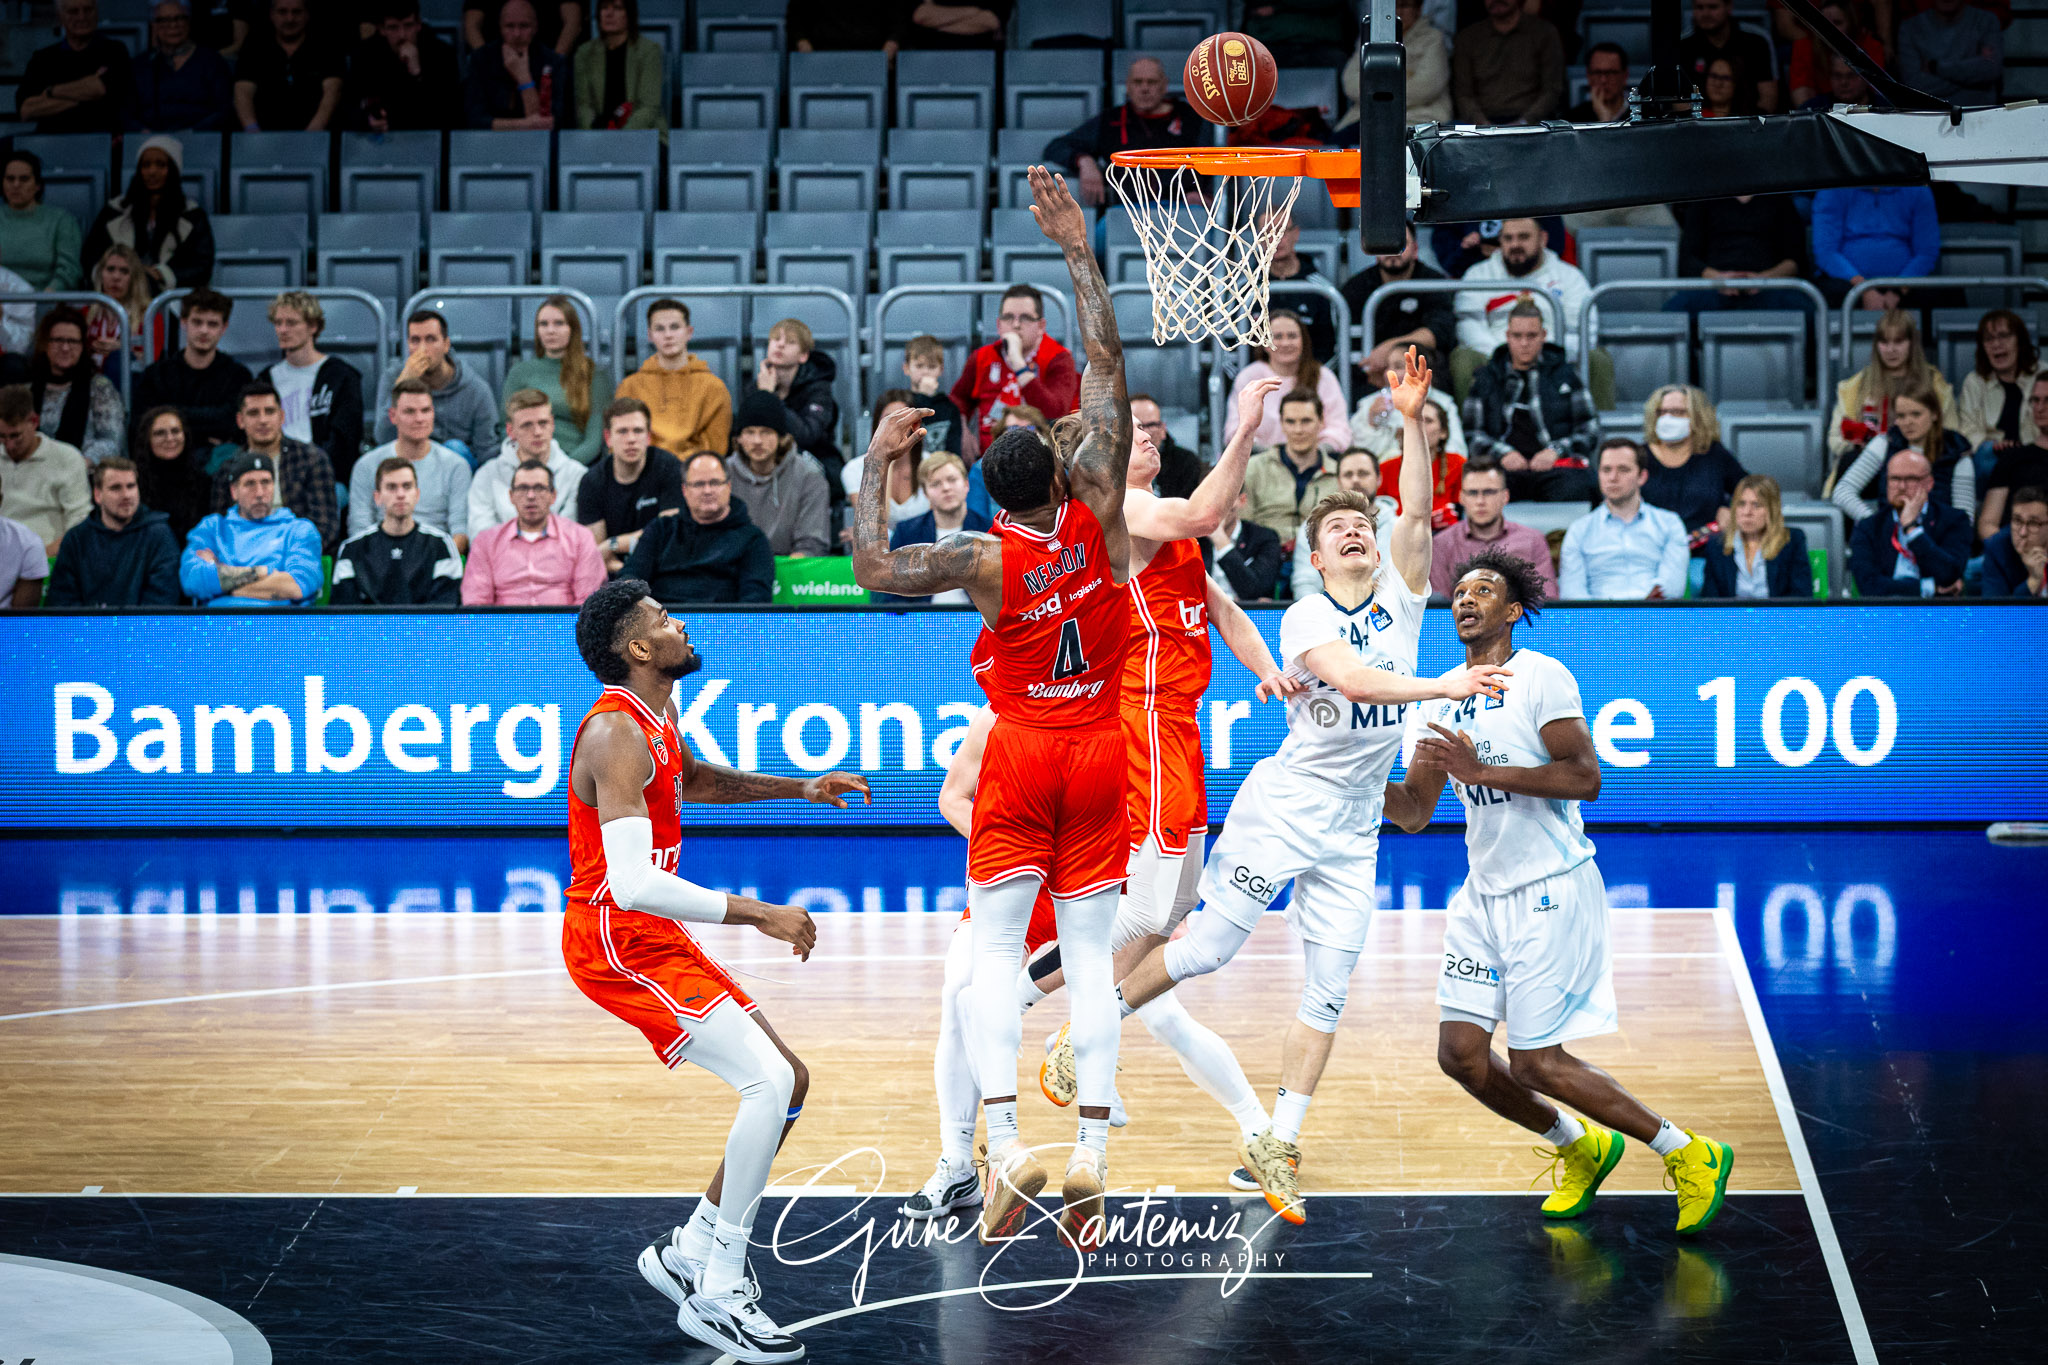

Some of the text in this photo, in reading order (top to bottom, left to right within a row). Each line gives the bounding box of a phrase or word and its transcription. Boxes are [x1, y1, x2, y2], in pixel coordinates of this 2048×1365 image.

[1199, 38, 1221, 100] SPALDING
[1237, 60, 1247, 81] BBL
[1068, 577, 1103, 602] logistics
[1019, 592, 1062, 622] xpd
[1052, 617, 1090, 681] 4
[1027, 679, 1105, 699] Bamberg
[53, 675, 563, 798] Bamberg
[1697, 675, 1898, 768] 100
